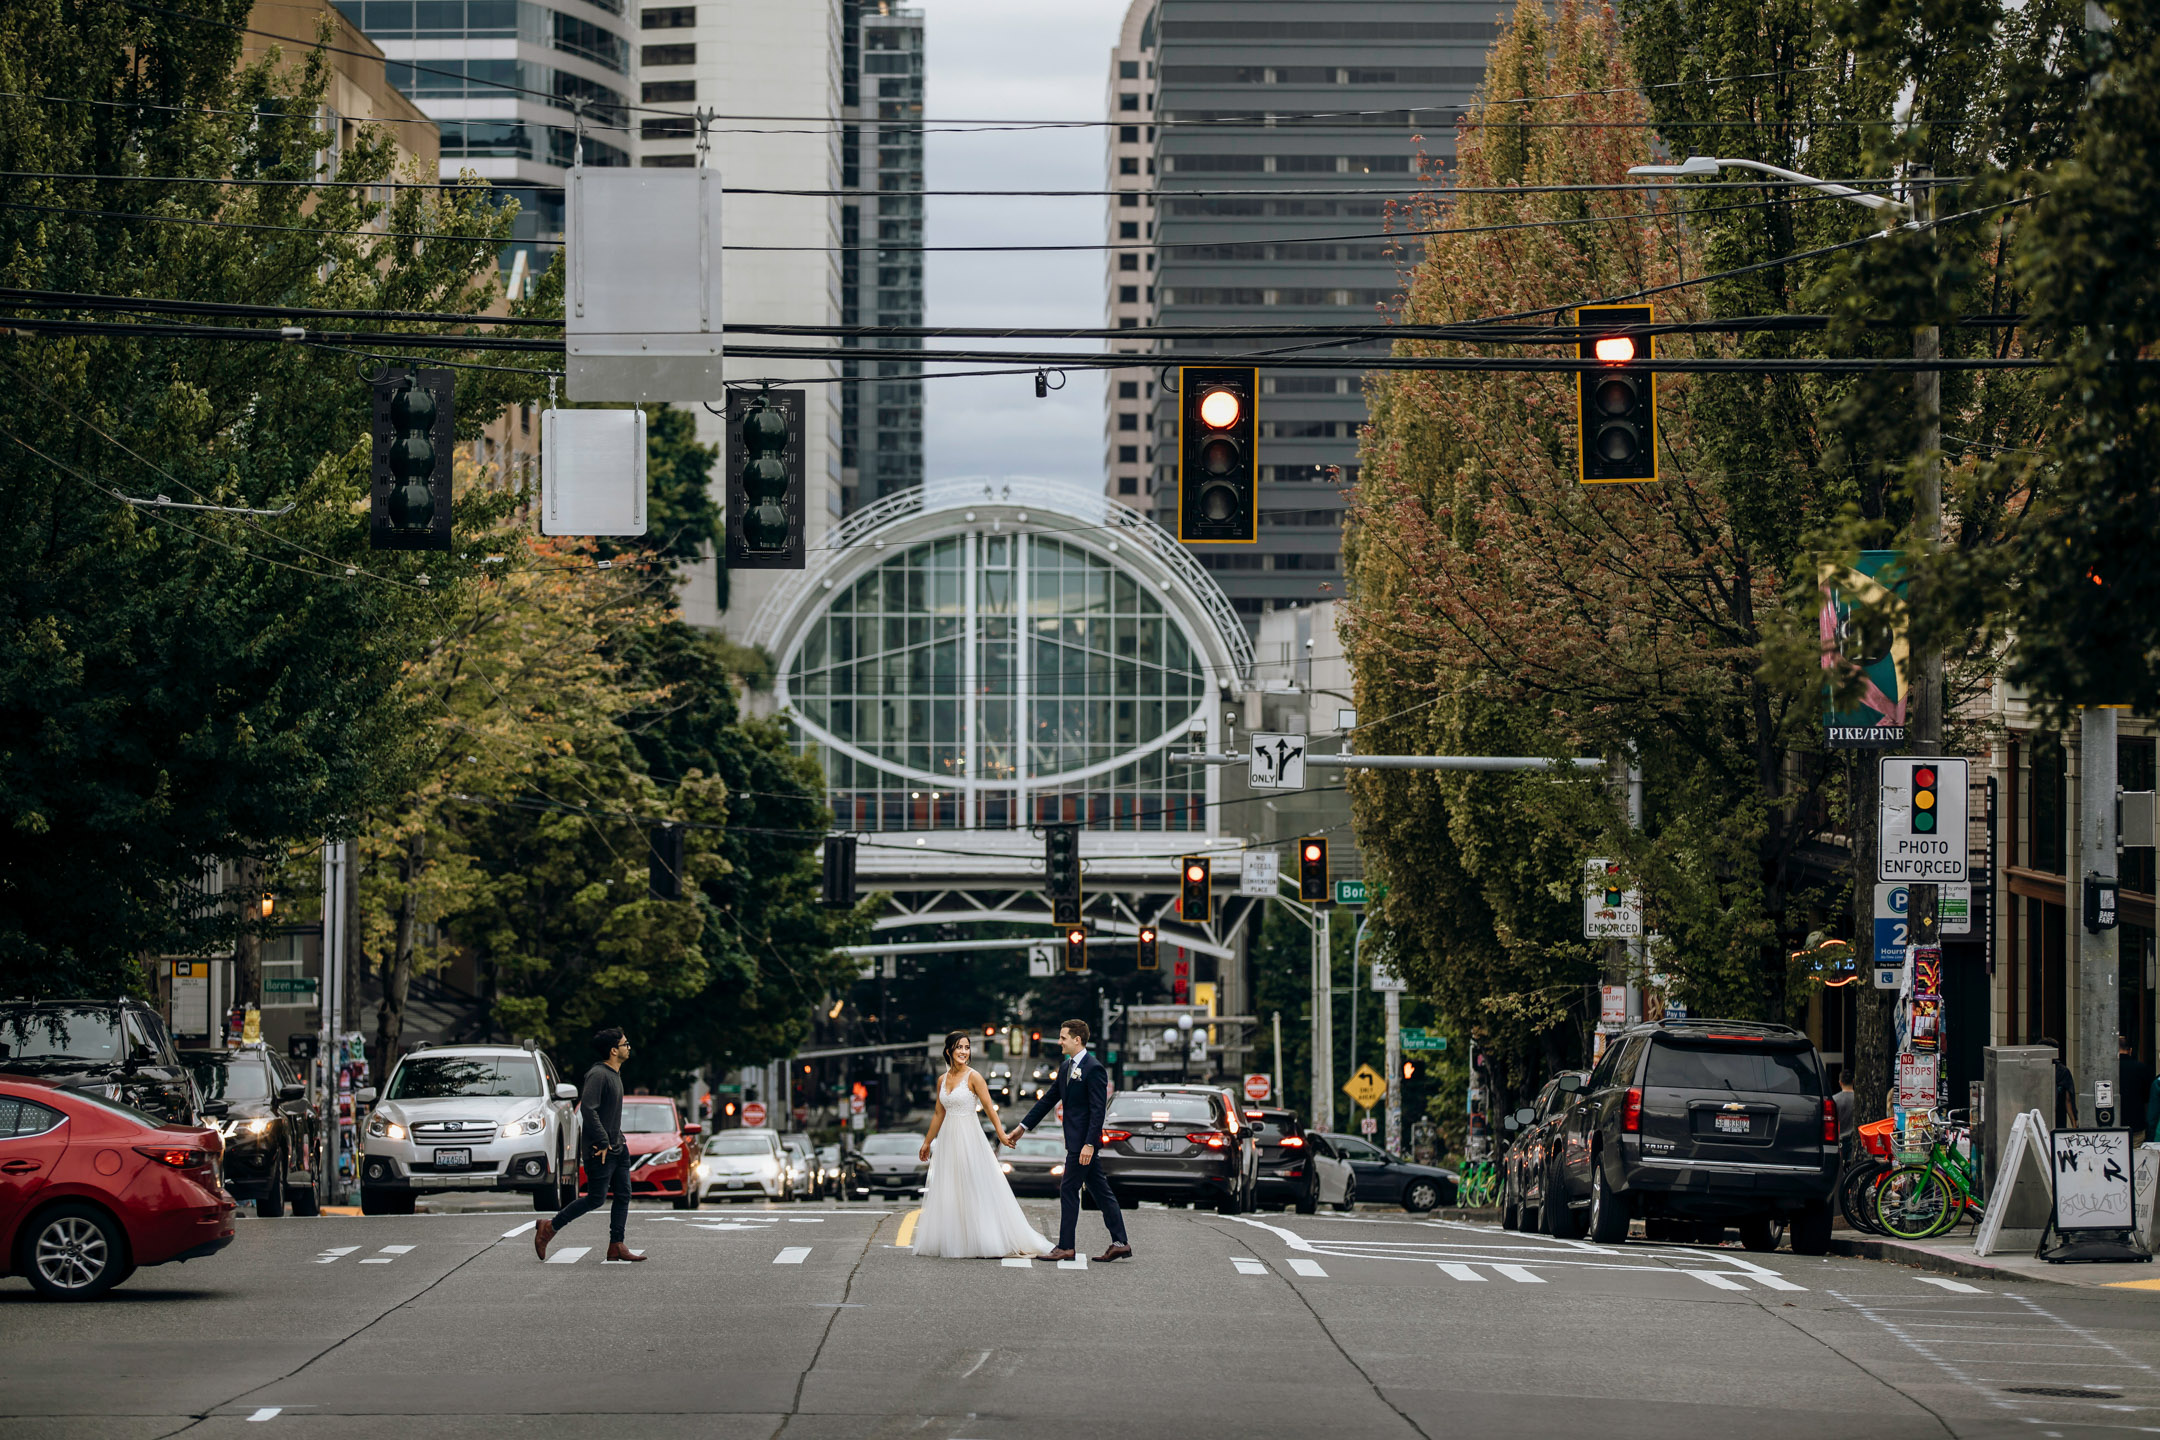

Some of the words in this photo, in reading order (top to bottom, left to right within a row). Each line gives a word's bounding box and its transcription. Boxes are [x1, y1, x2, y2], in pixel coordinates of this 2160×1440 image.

[1829, 728, 1904, 740] PIKE/PINE
[1251, 773, 1275, 783] ONLY
[1899, 841, 1949, 854] PHOTO
[1885, 860, 1962, 873] ENFORCED
[1892, 924, 1908, 945] 2
[266, 982, 290, 991] Boren
[1667, 1010, 1679, 1018] Pay
[1404, 1038, 1425, 1048] Boren
[1905, 1066, 1931, 1075] STOPS
